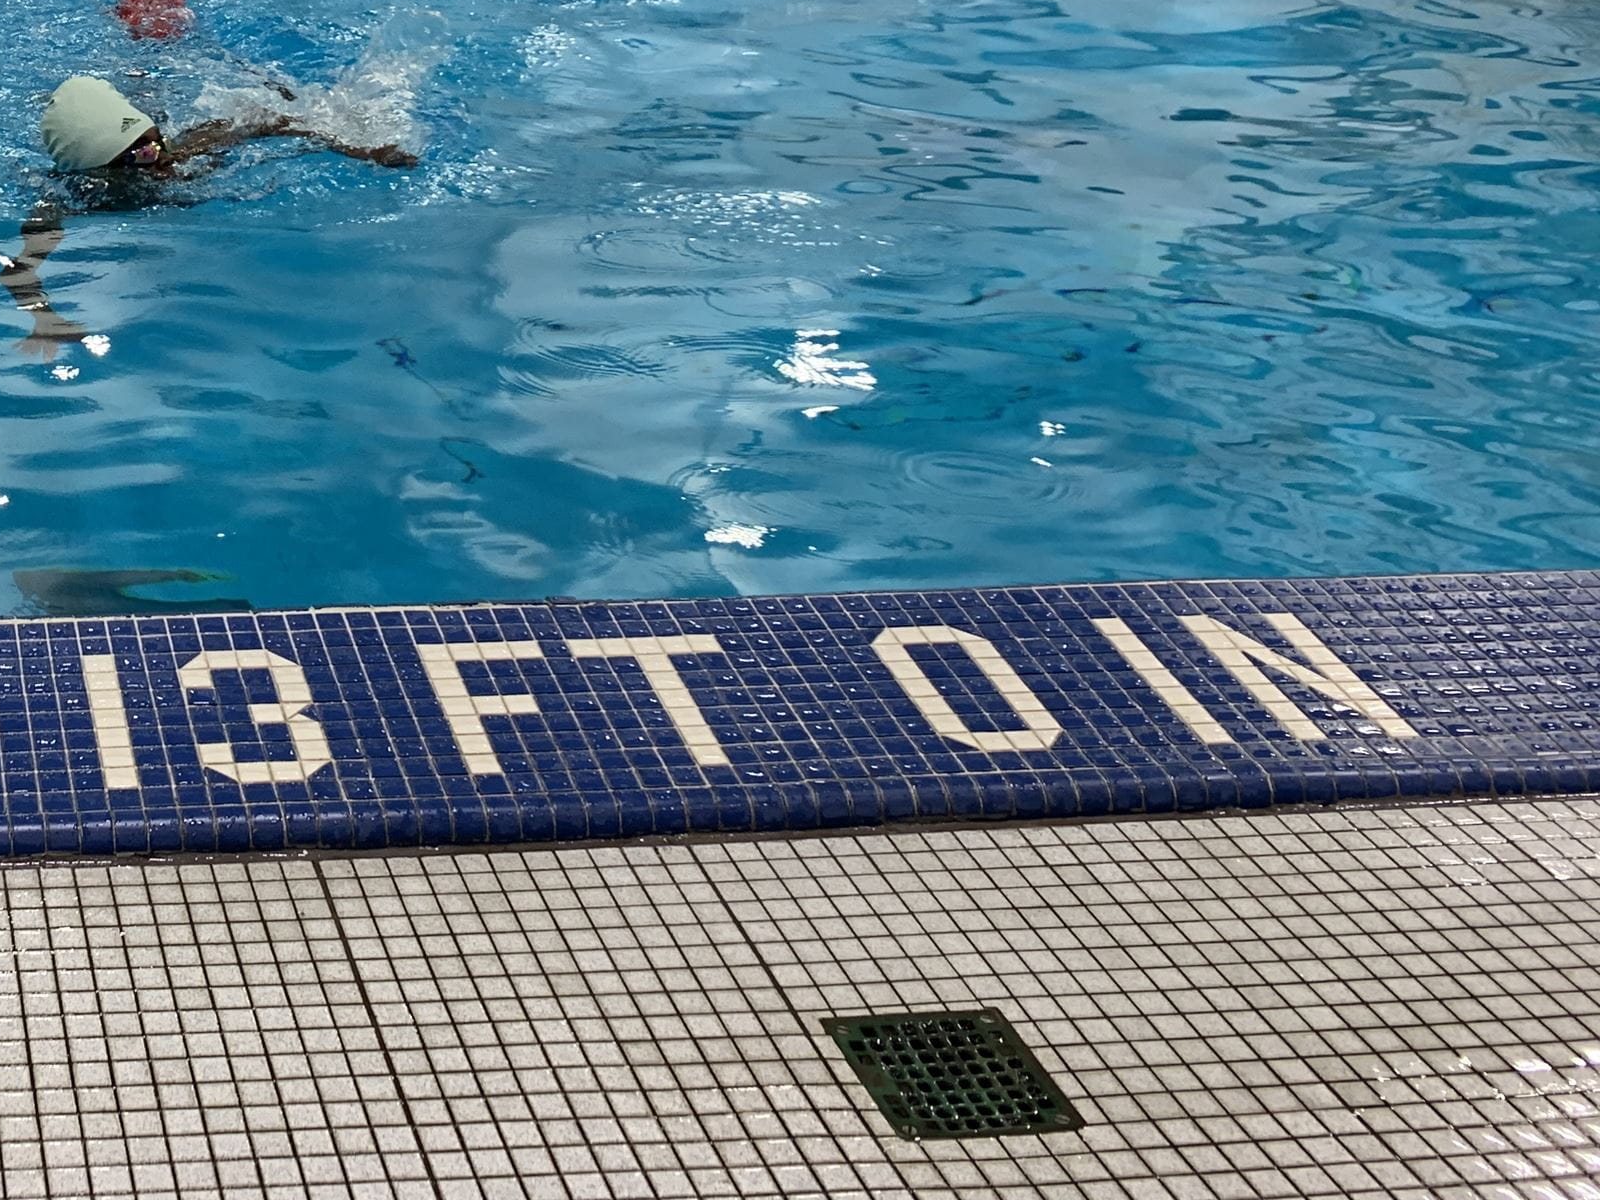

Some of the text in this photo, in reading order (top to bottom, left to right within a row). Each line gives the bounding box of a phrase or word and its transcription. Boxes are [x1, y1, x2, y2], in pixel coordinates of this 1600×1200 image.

[81, 648, 334, 788] 13
[417, 634, 731, 776] FT
[1092, 613, 1420, 746] IN
